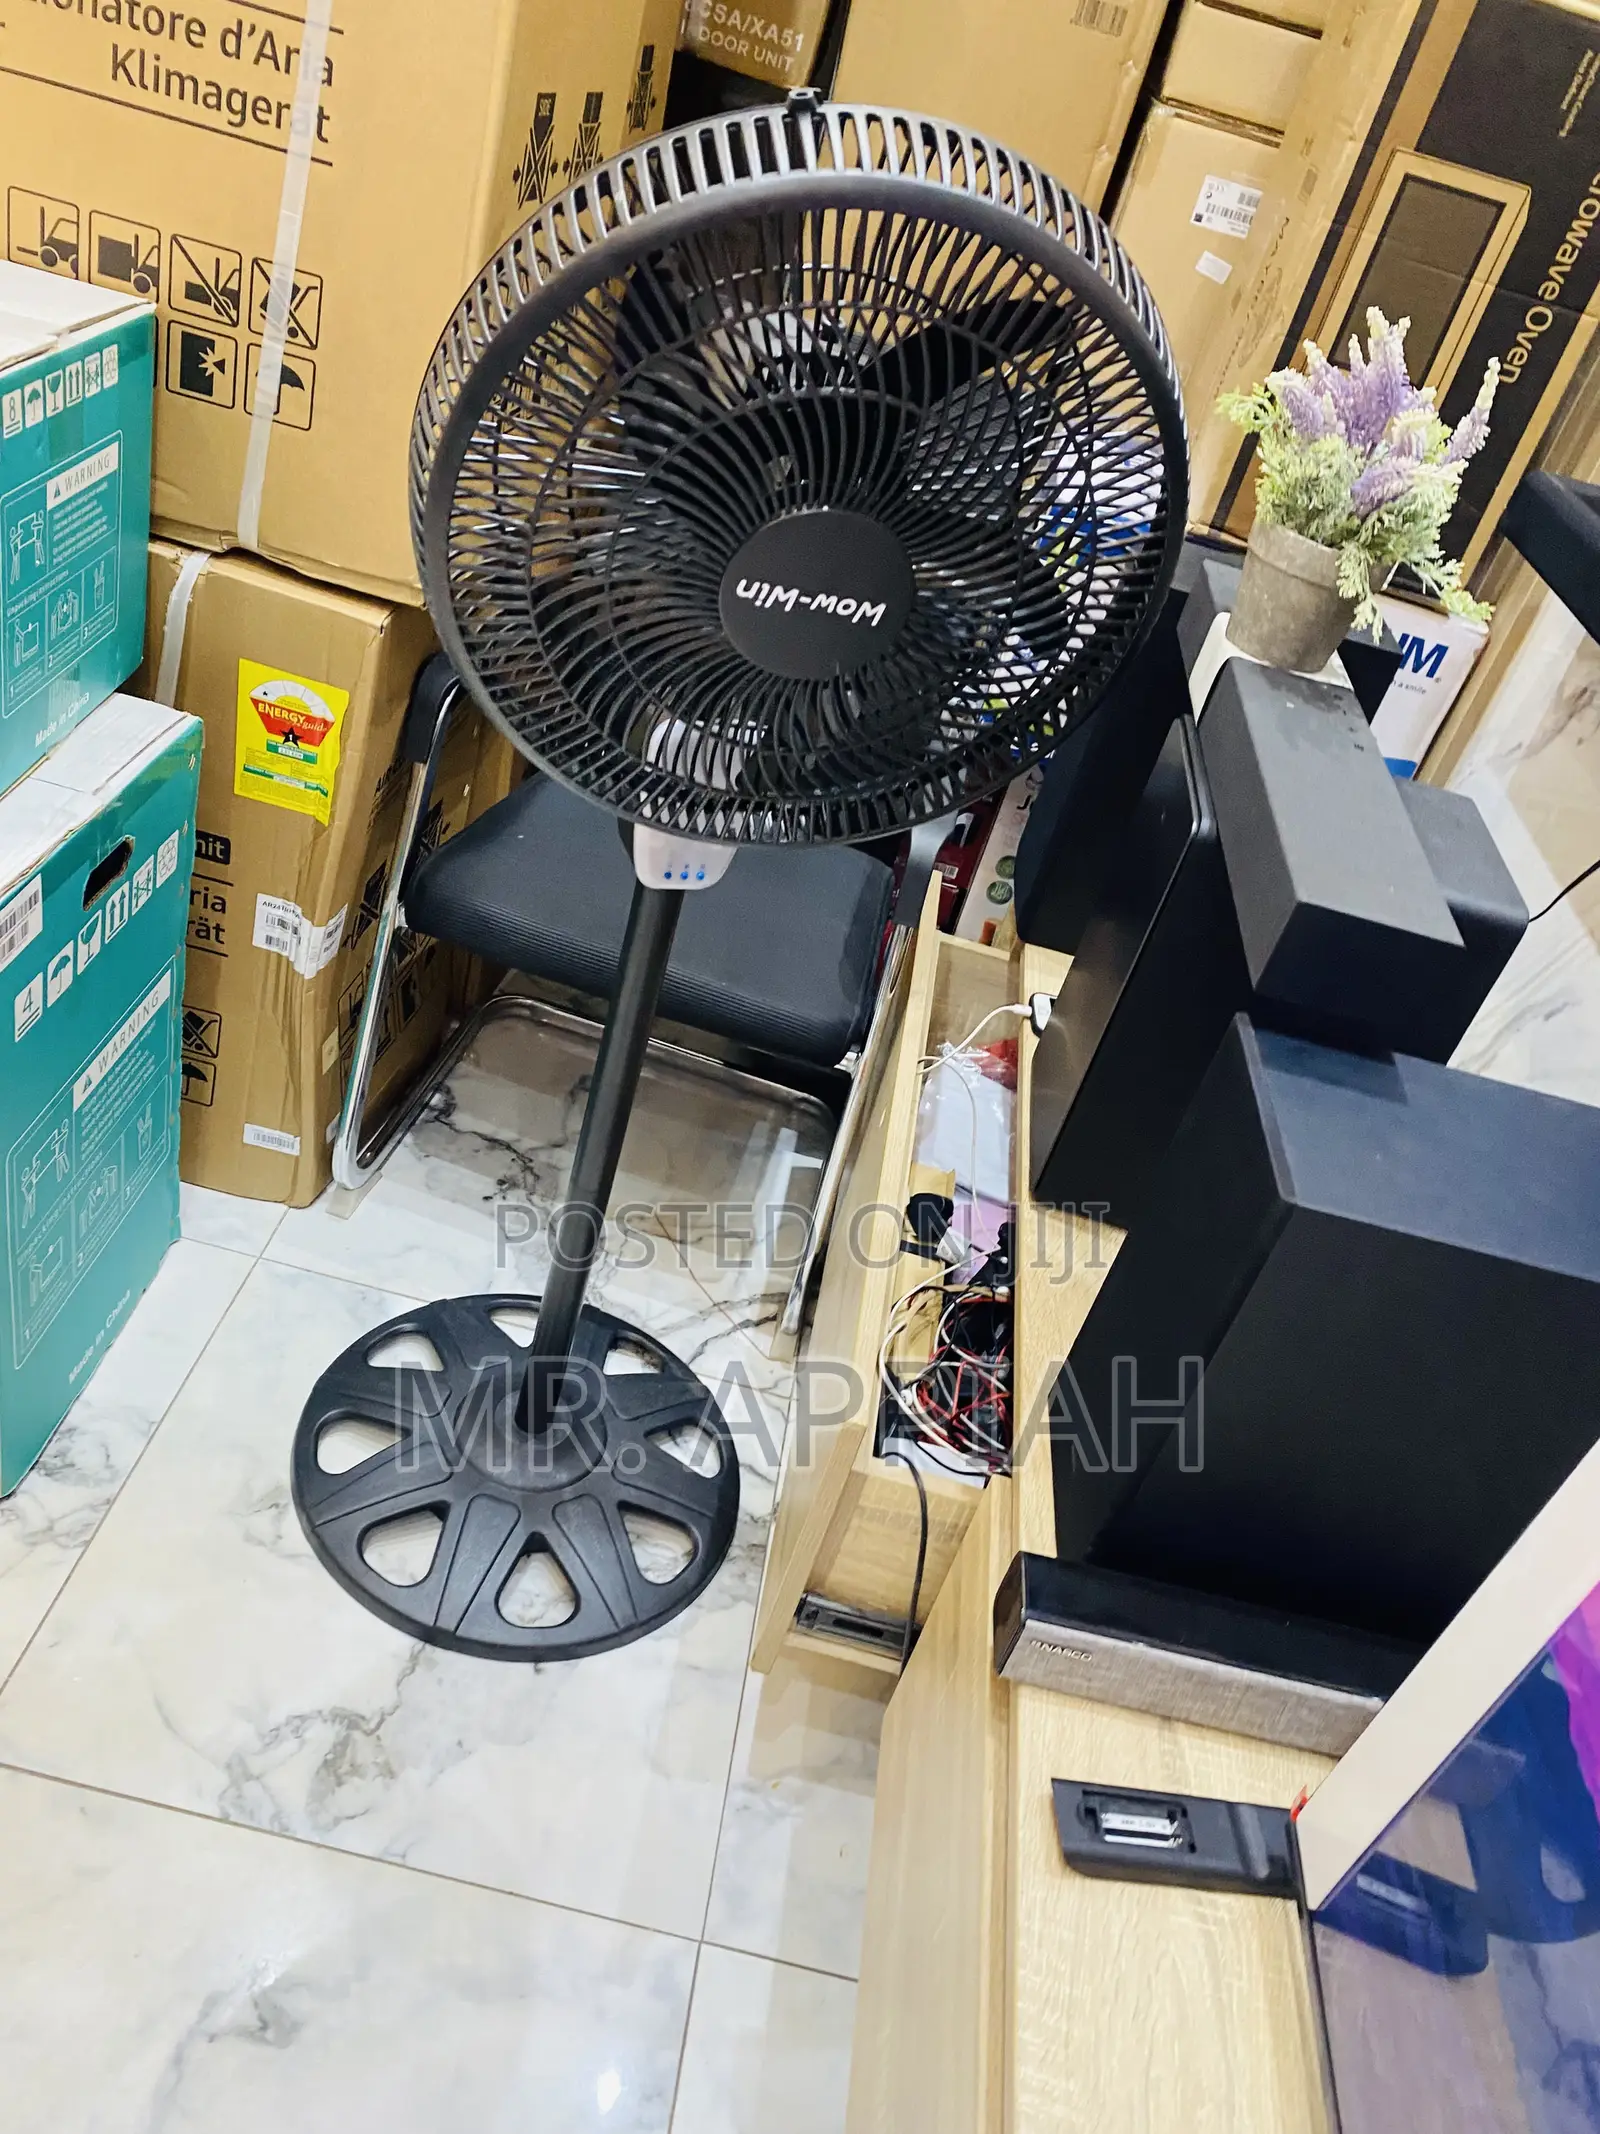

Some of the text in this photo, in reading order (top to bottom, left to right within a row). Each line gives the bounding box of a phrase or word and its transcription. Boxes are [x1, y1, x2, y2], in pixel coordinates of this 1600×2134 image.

[753, 45, 796, 73] UNIT
[1499, 305, 1553, 384] Oven
[9, 396, 16, 422] 8
[65, 452, 111, 492] WARNING
[258, 702, 307, 724] ENERGY
[196, 837, 226, 860] nit
[190, 886, 227, 915] ria
[187, 916, 226, 945] rät
[22, 986, 33, 1014] 4
[98, 990, 160, 1073] WARNING
